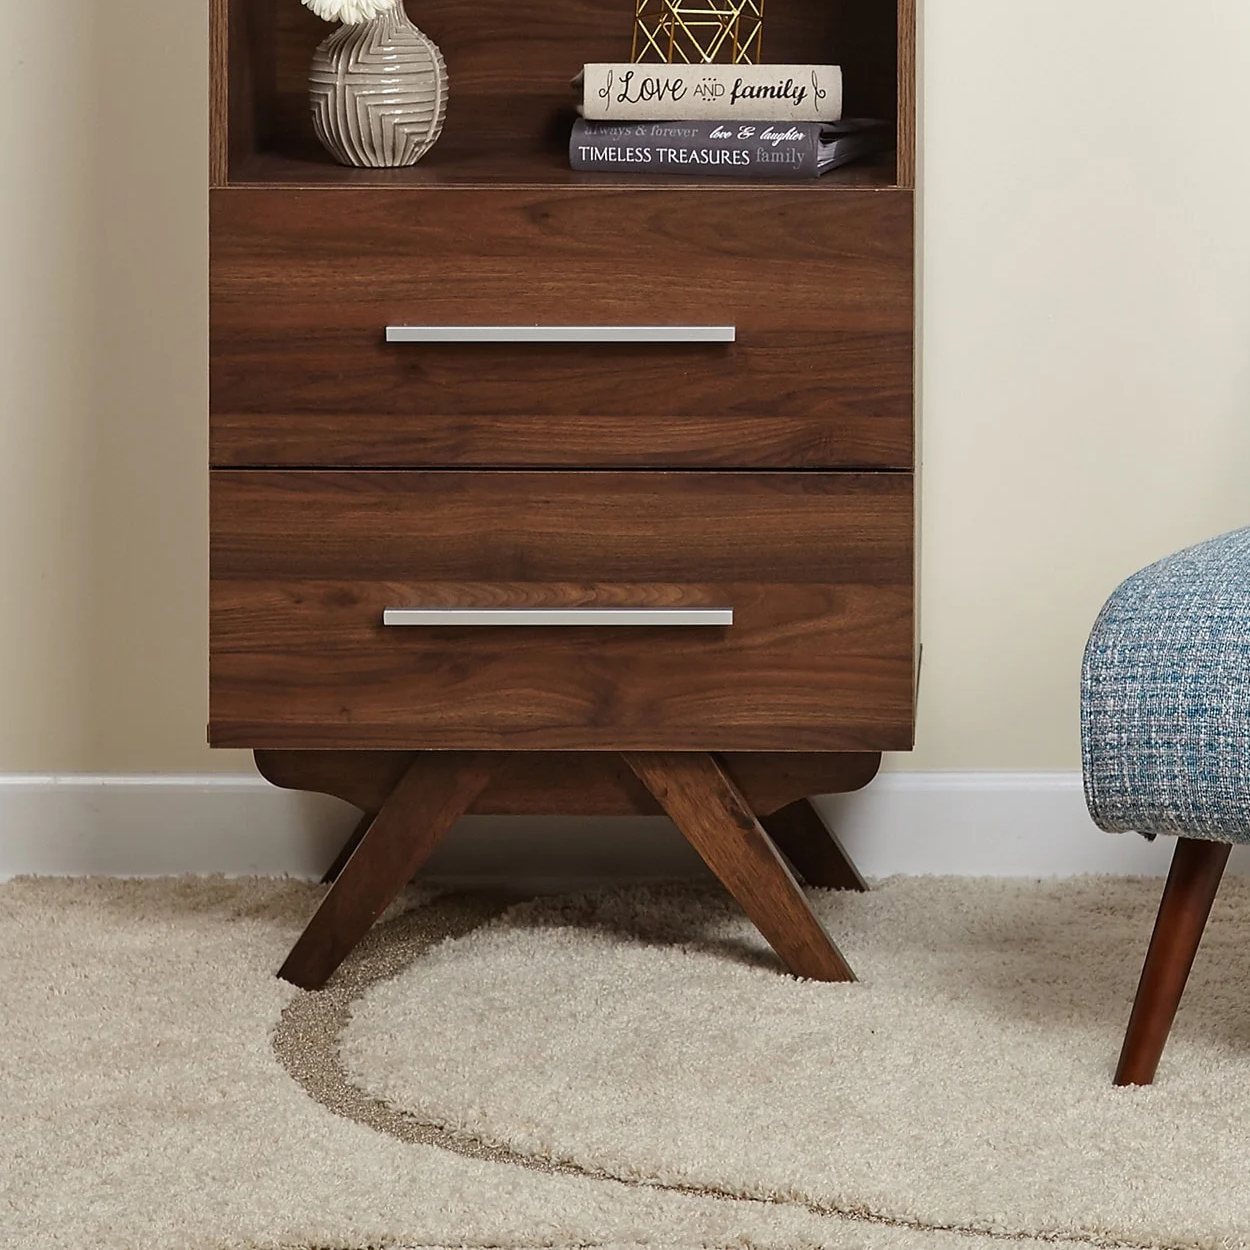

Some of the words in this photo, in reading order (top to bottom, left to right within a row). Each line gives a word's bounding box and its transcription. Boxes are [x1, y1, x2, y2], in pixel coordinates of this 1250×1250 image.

[693, 83, 726, 97] AND
[730, 78, 808, 106] family
[584, 125, 632, 141] always
[635, 126, 647, 136] &
[650, 125, 699, 138] forever
[709, 126, 732, 139] love
[737, 126, 756, 140] &
[760, 127, 805, 147] laughter
[578, 146, 652, 163] TIMELESS
[656, 148, 750, 166] TREASURES
[756, 147, 805, 170] family
